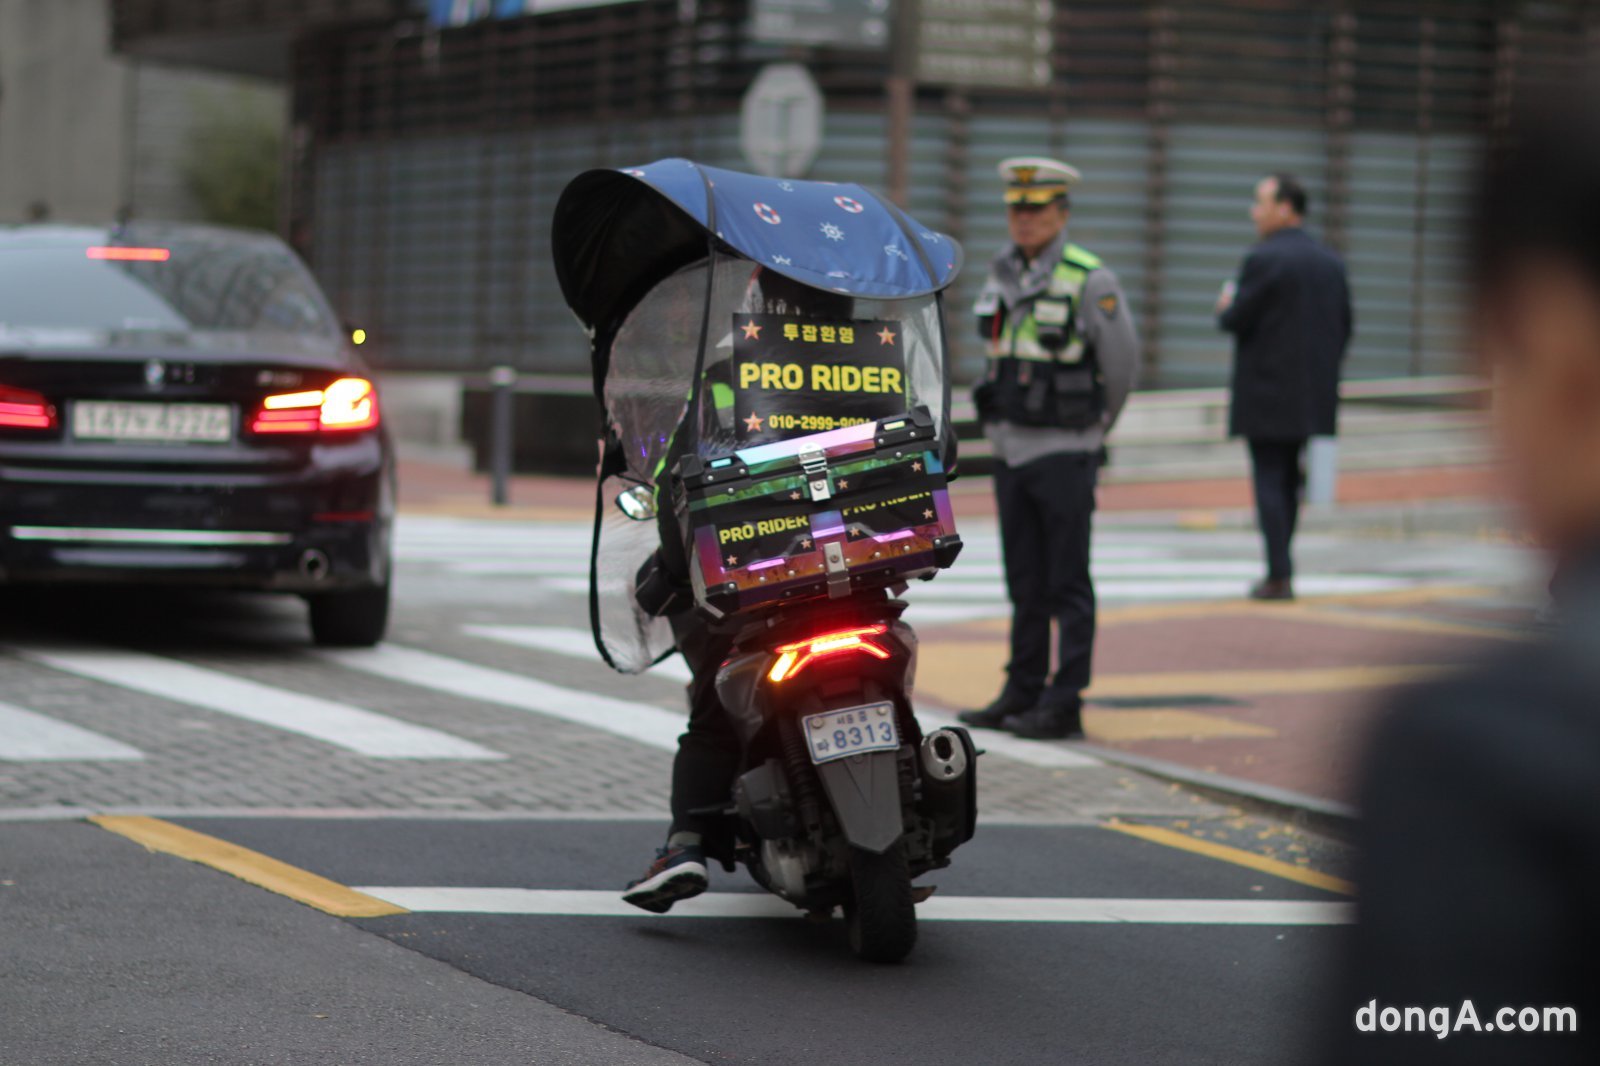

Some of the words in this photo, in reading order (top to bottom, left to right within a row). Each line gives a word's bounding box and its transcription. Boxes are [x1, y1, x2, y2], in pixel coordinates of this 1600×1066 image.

[783, 323, 854, 344] 투잡환영
[740, 363, 804, 391] PRO
[811, 365, 903, 394] RIDER
[719, 524, 755, 544] PRO
[757, 515, 809, 536] RIDER
[833, 721, 892, 749] 8313
